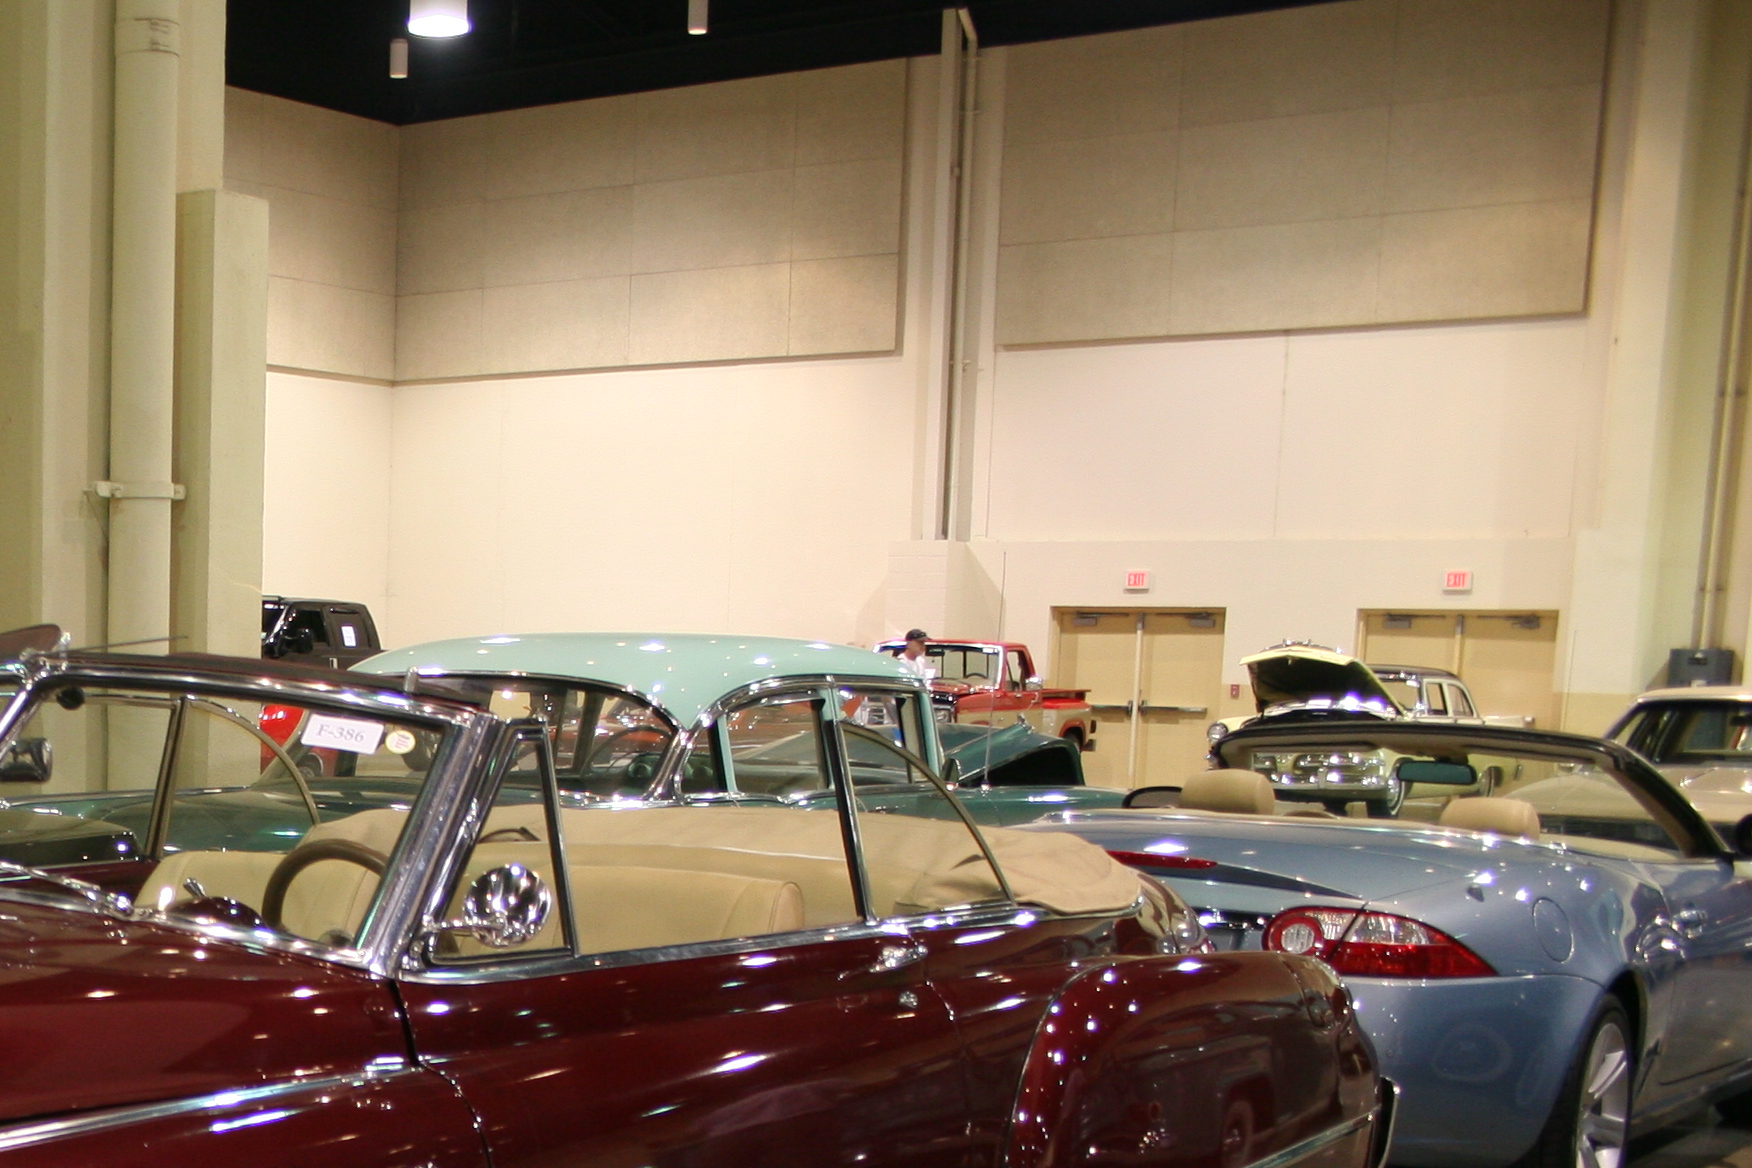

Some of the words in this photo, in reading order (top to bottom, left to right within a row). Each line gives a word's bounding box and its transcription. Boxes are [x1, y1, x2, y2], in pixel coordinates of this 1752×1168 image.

[1128, 573, 1146, 587] EXIT
[1447, 573, 1467, 588] EXIT
[315, 723, 365, 743] F-386
